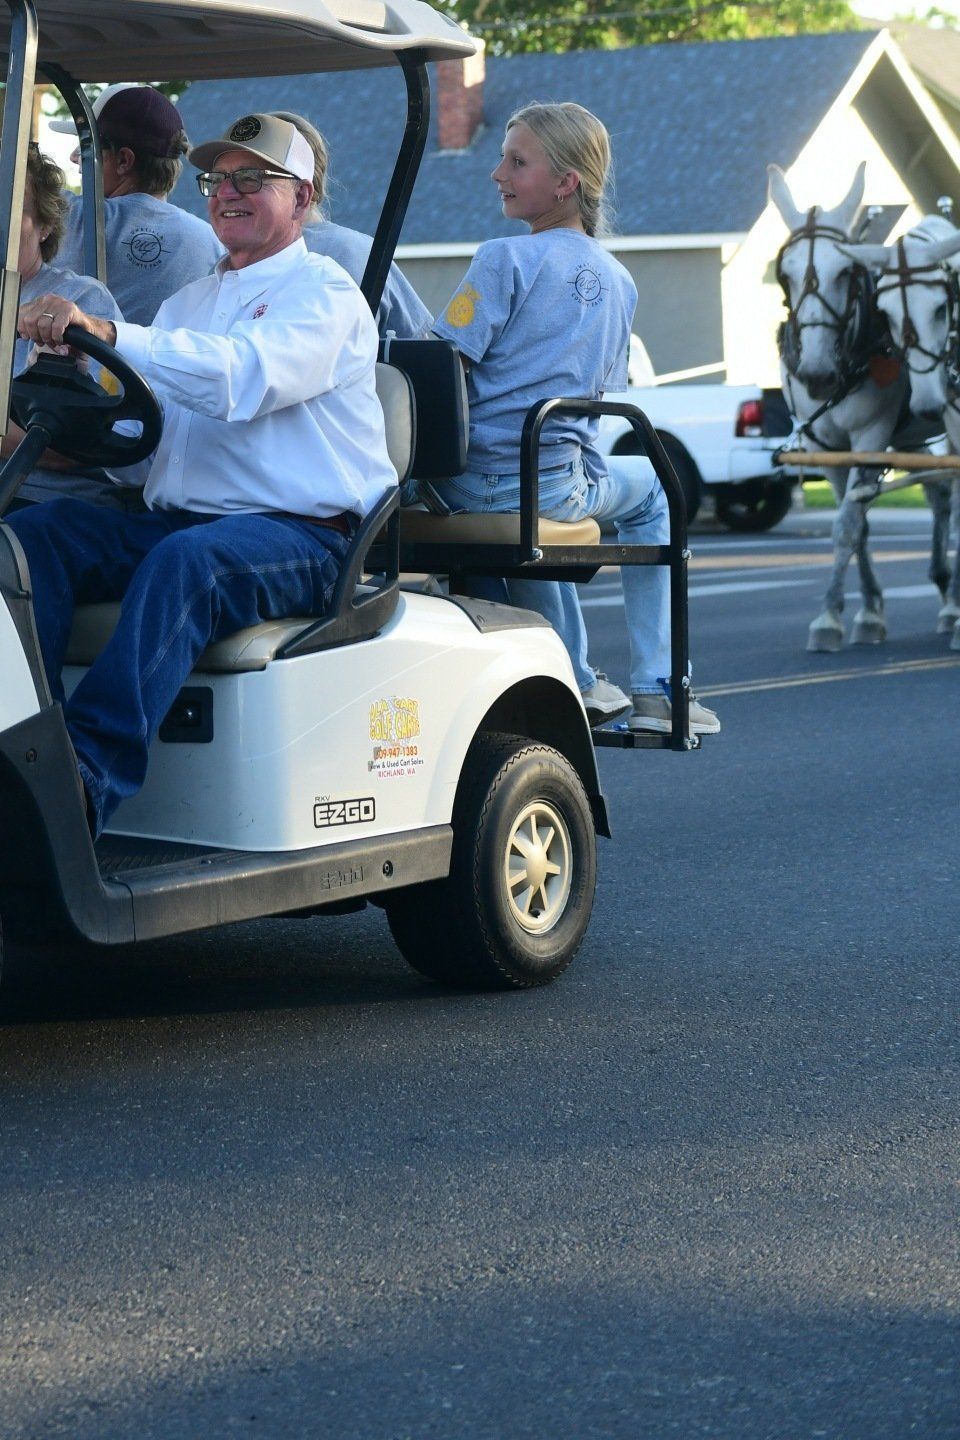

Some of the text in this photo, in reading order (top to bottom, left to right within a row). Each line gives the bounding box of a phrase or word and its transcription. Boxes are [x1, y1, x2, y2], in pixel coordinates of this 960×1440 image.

[369, 712, 393, 740] GOLF
[373, 746, 418, 760] 09-947-1383
[386, 760, 400, 768] Used
[400, 759, 410, 767] Cart
[411, 758, 424, 766] Sales
[378, 767, 416, 778] RICHLAND WA
[314, 799, 374, 826] EZGO
